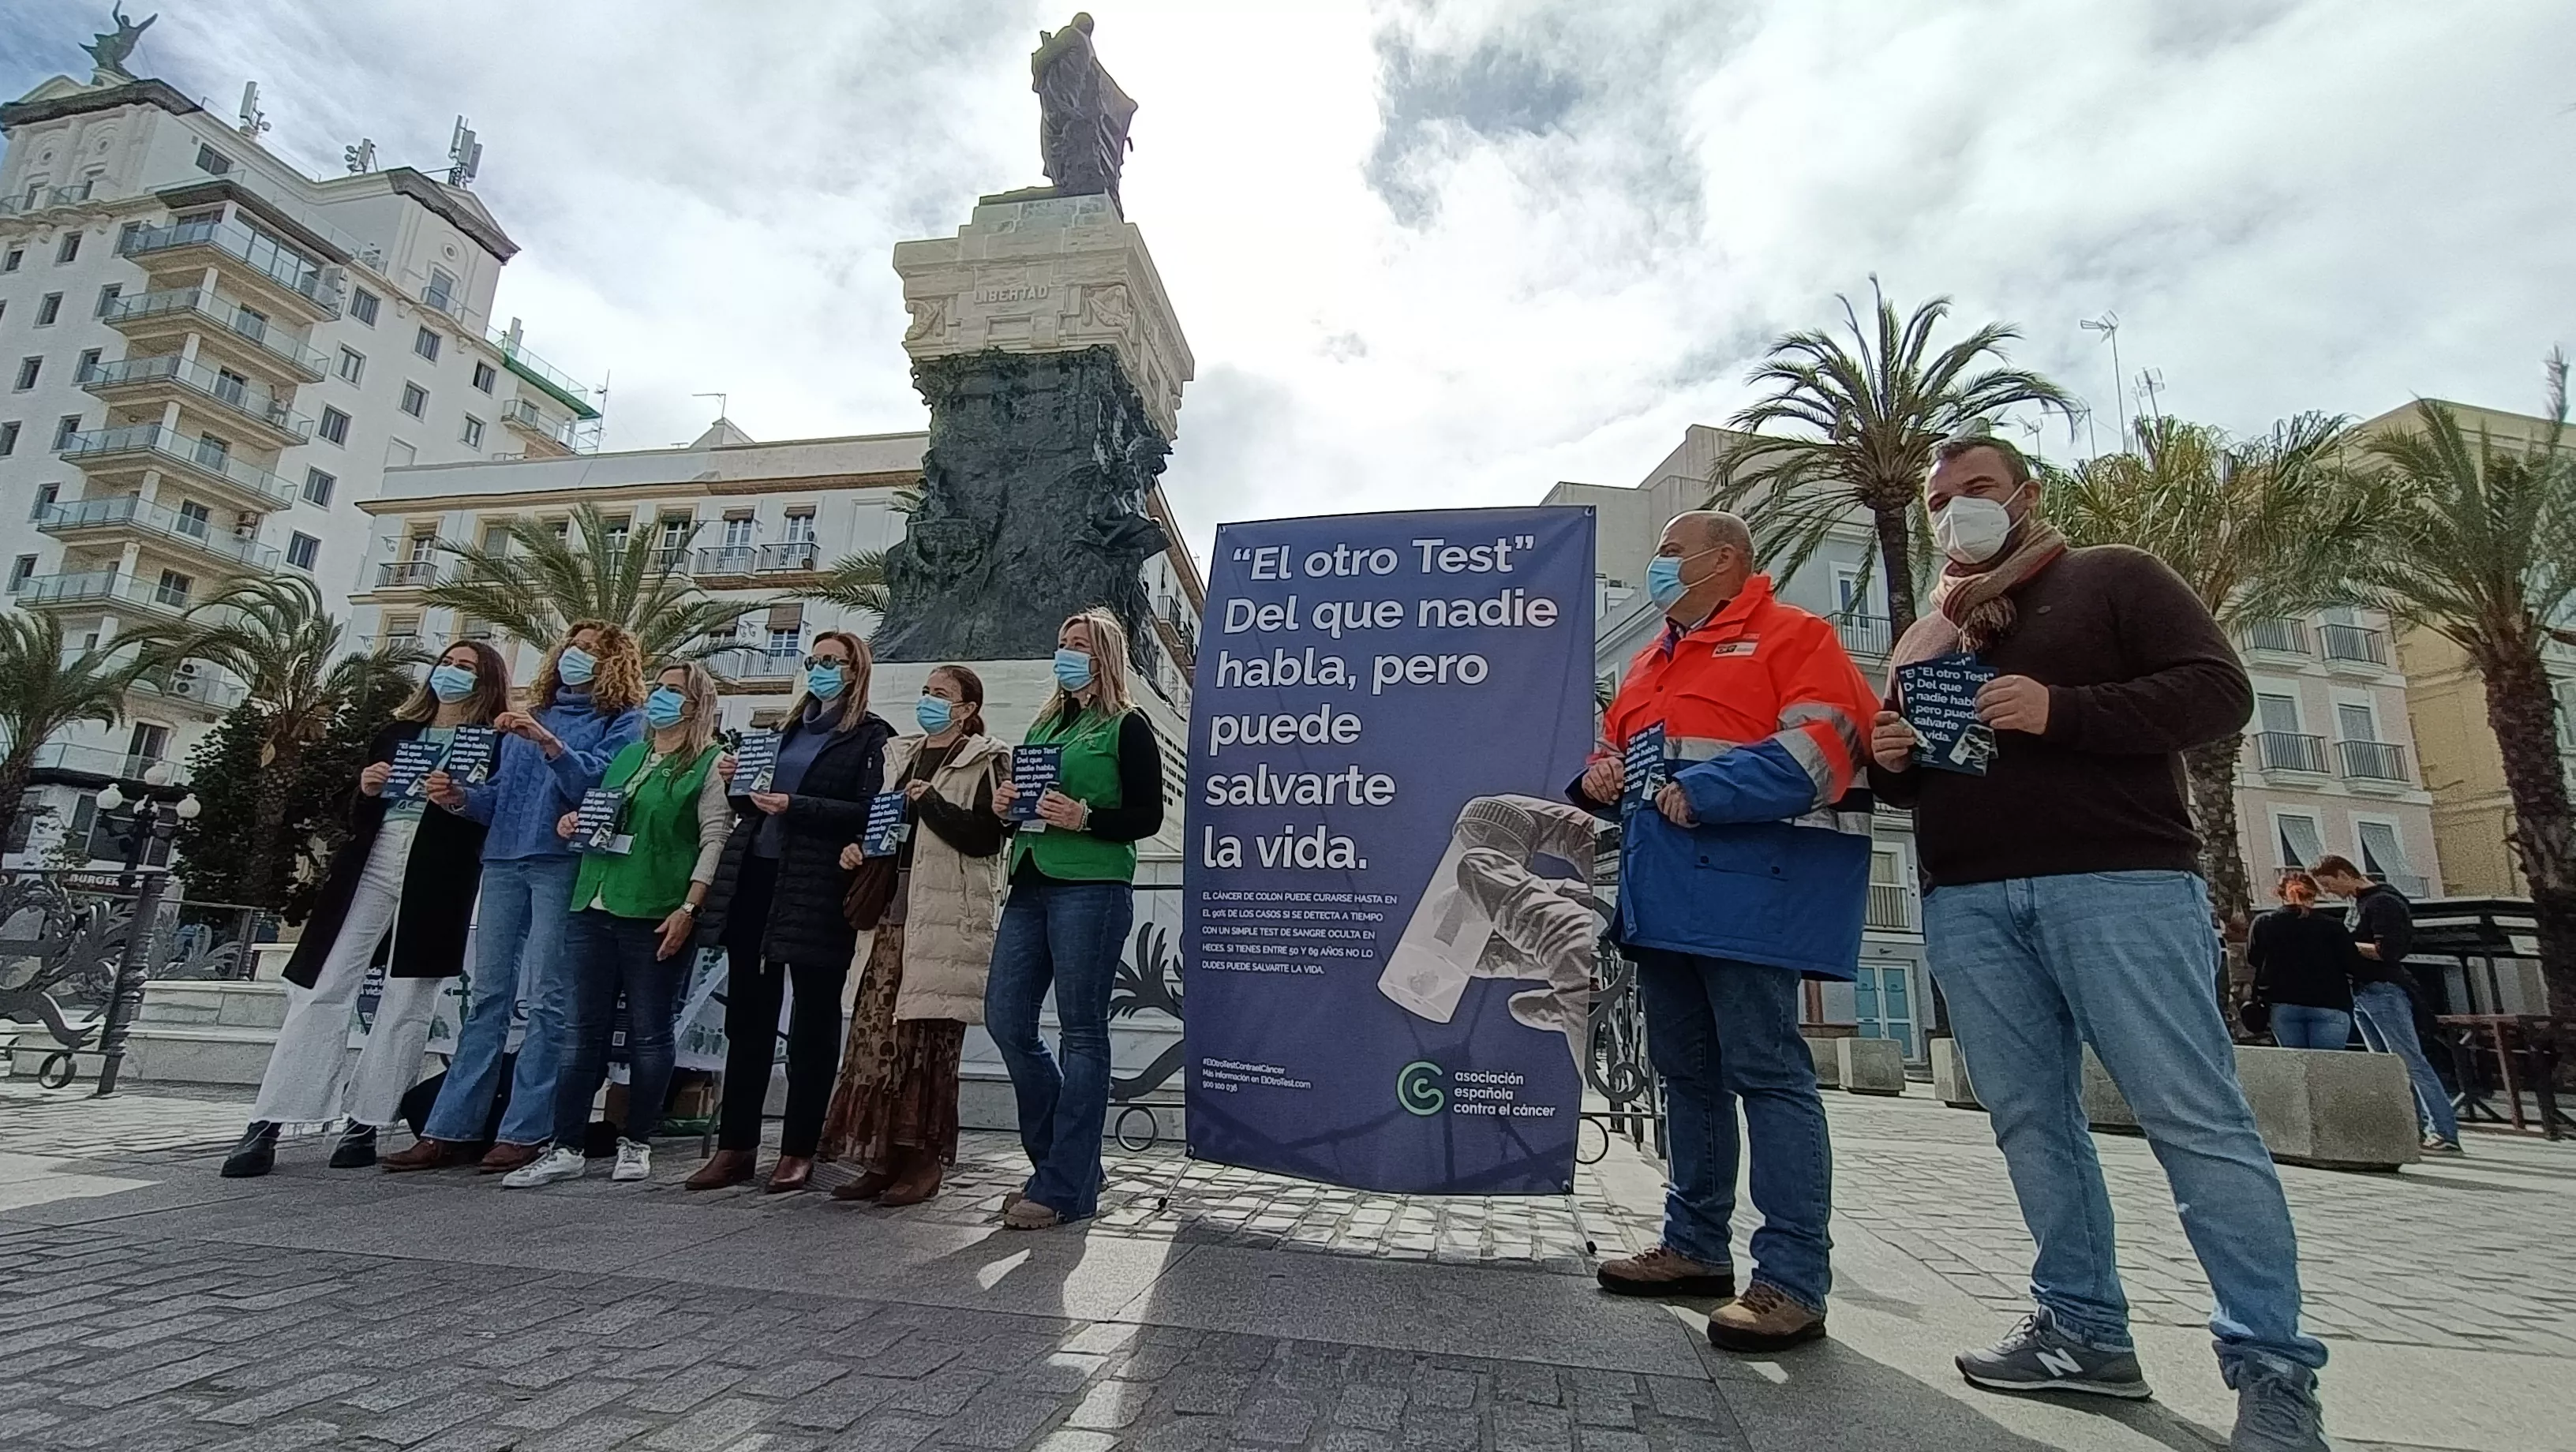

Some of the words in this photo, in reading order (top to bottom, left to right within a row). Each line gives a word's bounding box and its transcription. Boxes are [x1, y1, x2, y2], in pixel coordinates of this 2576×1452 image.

[973, 285, 1049, 305] LIBERTAD
[1232, 543, 1292, 581] “El
[1304, 542, 1398, 578] otro
[1412, 534, 1535, 575] Test”
[1222, 595, 1299, 634] Del
[1312, 598, 1404, 639] que
[1417, 588, 1558, 628] nadie
[1215, 647, 1357, 690] habla,
[1372, 652, 1488, 696] pero
[1936, 668, 1960, 680] otro
[1916, 679, 1937, 690] Del
[1938, 682, 1963, 694] que
[1915, 692, 1948, 704] nadie
[1950, 694, 1976, 707] habl
[1915, 705, 1942, 715] pero
[1209, 703, 1362, 757] puede
[1913, 717, 1960, 731] salvarte
[1204, 764, 1396, 807] salvarte
[1203, 825, 1242, 869] la
[1256, 825, 1368, 870] vida.
[1202, 891, 1211, 900] EL
[1212, 889, 1242, 900] CÁNCER
[1243, 892, 1255, 900] DE
[1255, 893, 1283, 901] COLON
[1284, 893, 1312, 902] PUEDE
[1312, 893, 1353, 903] CURARSE
[1354, 894, 1383, 904] HASTA
[1384, 896, 1398, 904] EN
[1202, 908, 1211, 917] EL
[1211, 909, 1226, 919] 90%
[1227, 909, 1238, 918] DE
[1238, 909, 1254, 918] LOS
[1255, 910, 1282, 919] CASOS
[1282, 910, 1290, 919] SI
[1291, 910, 1302, 919] SE
[1303, 911, 1341, 920] DETECTA
[1342, 911, 1350, 920] A
[1350, 911, 1383, 922] TIEMPO
[1202, 926, 1218, 934] CON
[1230, 926, 1258, 936] SIMPLE
[1259, 927, 1279, 936] TEST
[1279, 927, 1291, 937] DE
[1292, 928, 1326, 937] SANGRE
[1327, 930, 1361, 939] OCULTA
[1362, 930, 1376, 940] EN
[1226, 944, 1234, 952] SI
[1234, 944, 1261, 954] TIENES
[1262, 945, 1288, 955] ENTRE
[1289, 947, 1299, 956] 50
[1300, 946, 1307, 955] Y
[1308, 947, 1319, 957] 69
[1320, 945, 1344, 956] AÑOS
[1345, 948, 1360, 957] NO
[1361, 949, 1373, 958] LO
[1202, 960, 1226, 970] DUDES
[1226, 961, 1251, 971] PUEDE
[1252, 962, 1290, 972] SALVARTE
[1290, 964, 1302, 973] LA
[1202, 1068, 1214, 1077] Más
[1215, 1070, 1250, 1083] información
[1260, 1075, 1311, 1089] ElOtroTest.com
[1202, 1080, 1214, 1089] 900
[1455, 1070, 1524, 1086] asociación
[1454, 1087, 1514, 1101] española
[1453, 1102, 1496, 1116] contra
[1498, 1103, 1510, 1116] el
[1512, 1103, 1556, 1117] cáncer
